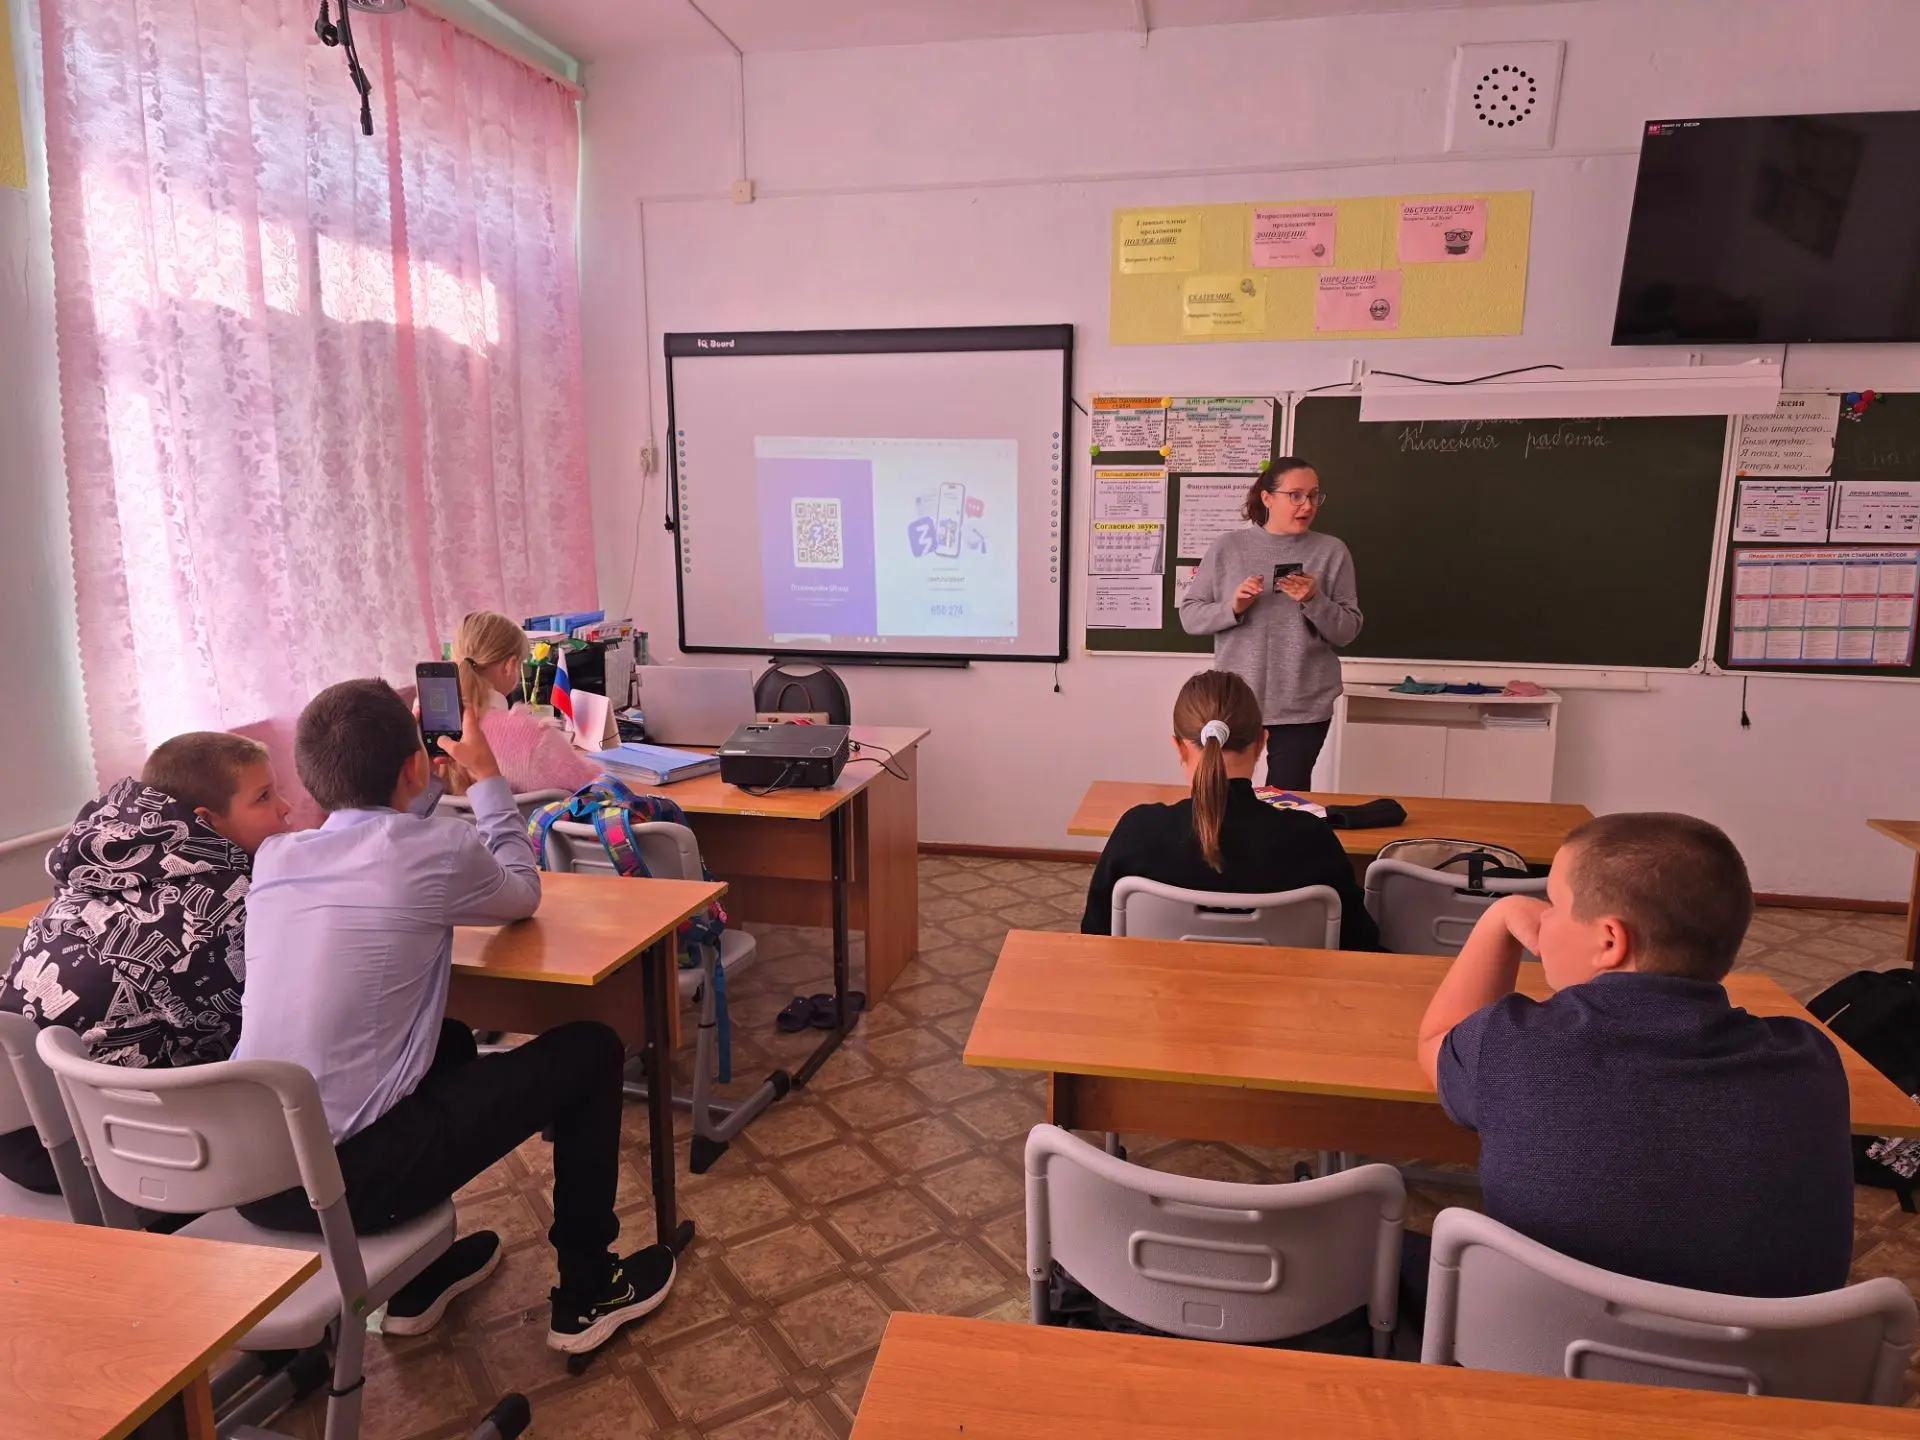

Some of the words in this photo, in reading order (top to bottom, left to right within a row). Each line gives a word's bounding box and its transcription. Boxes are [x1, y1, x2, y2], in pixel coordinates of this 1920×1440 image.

[1743, 424, 1769, 433] Было
[1398, 427, 1500, 451] Классная
[1525, 423, 1611, 459] работа
[1741, 437, 1767, 446] Было
[1740, 449, 1749, 457] Я
[1740, 462, 1771, 470] Теперь
[1232, 483, 1252, 491] разбо
[1095, 522, 1136, 530] Согласные
